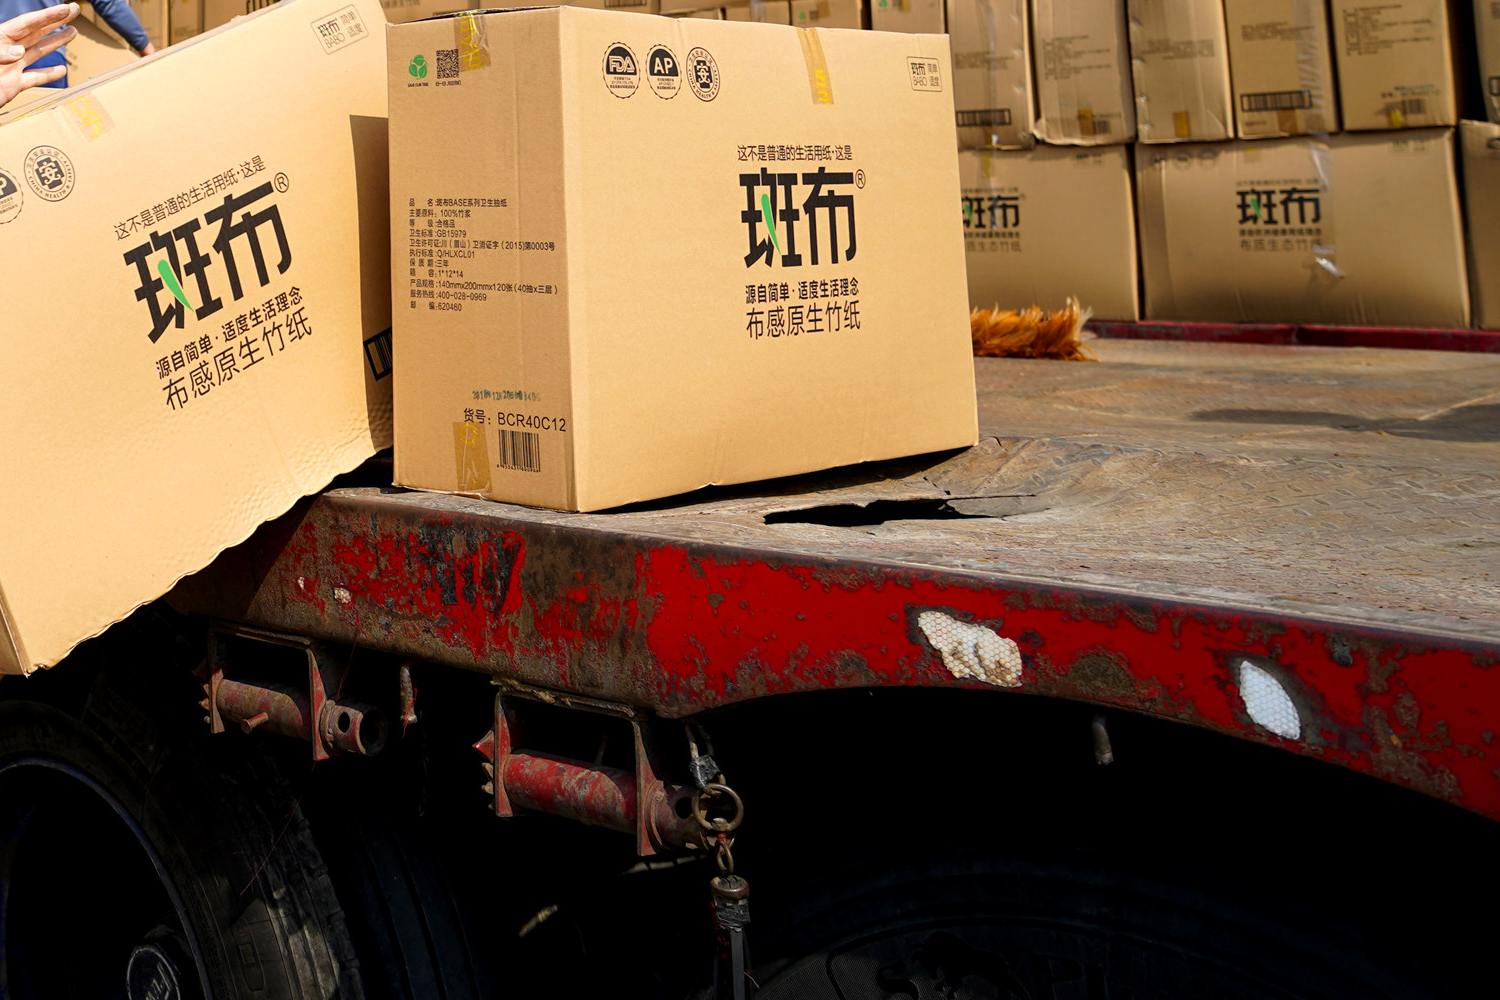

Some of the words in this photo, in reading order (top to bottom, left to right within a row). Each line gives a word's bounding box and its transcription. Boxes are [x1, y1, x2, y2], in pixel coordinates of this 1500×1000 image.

[608, 55, 635, 73] FDA
[654, 57, 674, 74] AP
[737, 145, 852, 162] 这不是普通的生活用纸·这是
[113, 155, 267, 240] 这不是普通的生活用纸·这是
[1236, 187, 1321, 225] 斑布
[739, 166, 857, 269] 斑布
[123, 180, 293, 344] 斑布
[745, 277, 860, 305] 源自简单·适度生活理念
[155, 286, 304, 380] 源自简单·适度生活理念
[746, 300, 861, 340] 布感原生竹纸
[162, 306, 314, 412] 布感原生竹纸
[498, 412, 566, 432] BCR40C12
